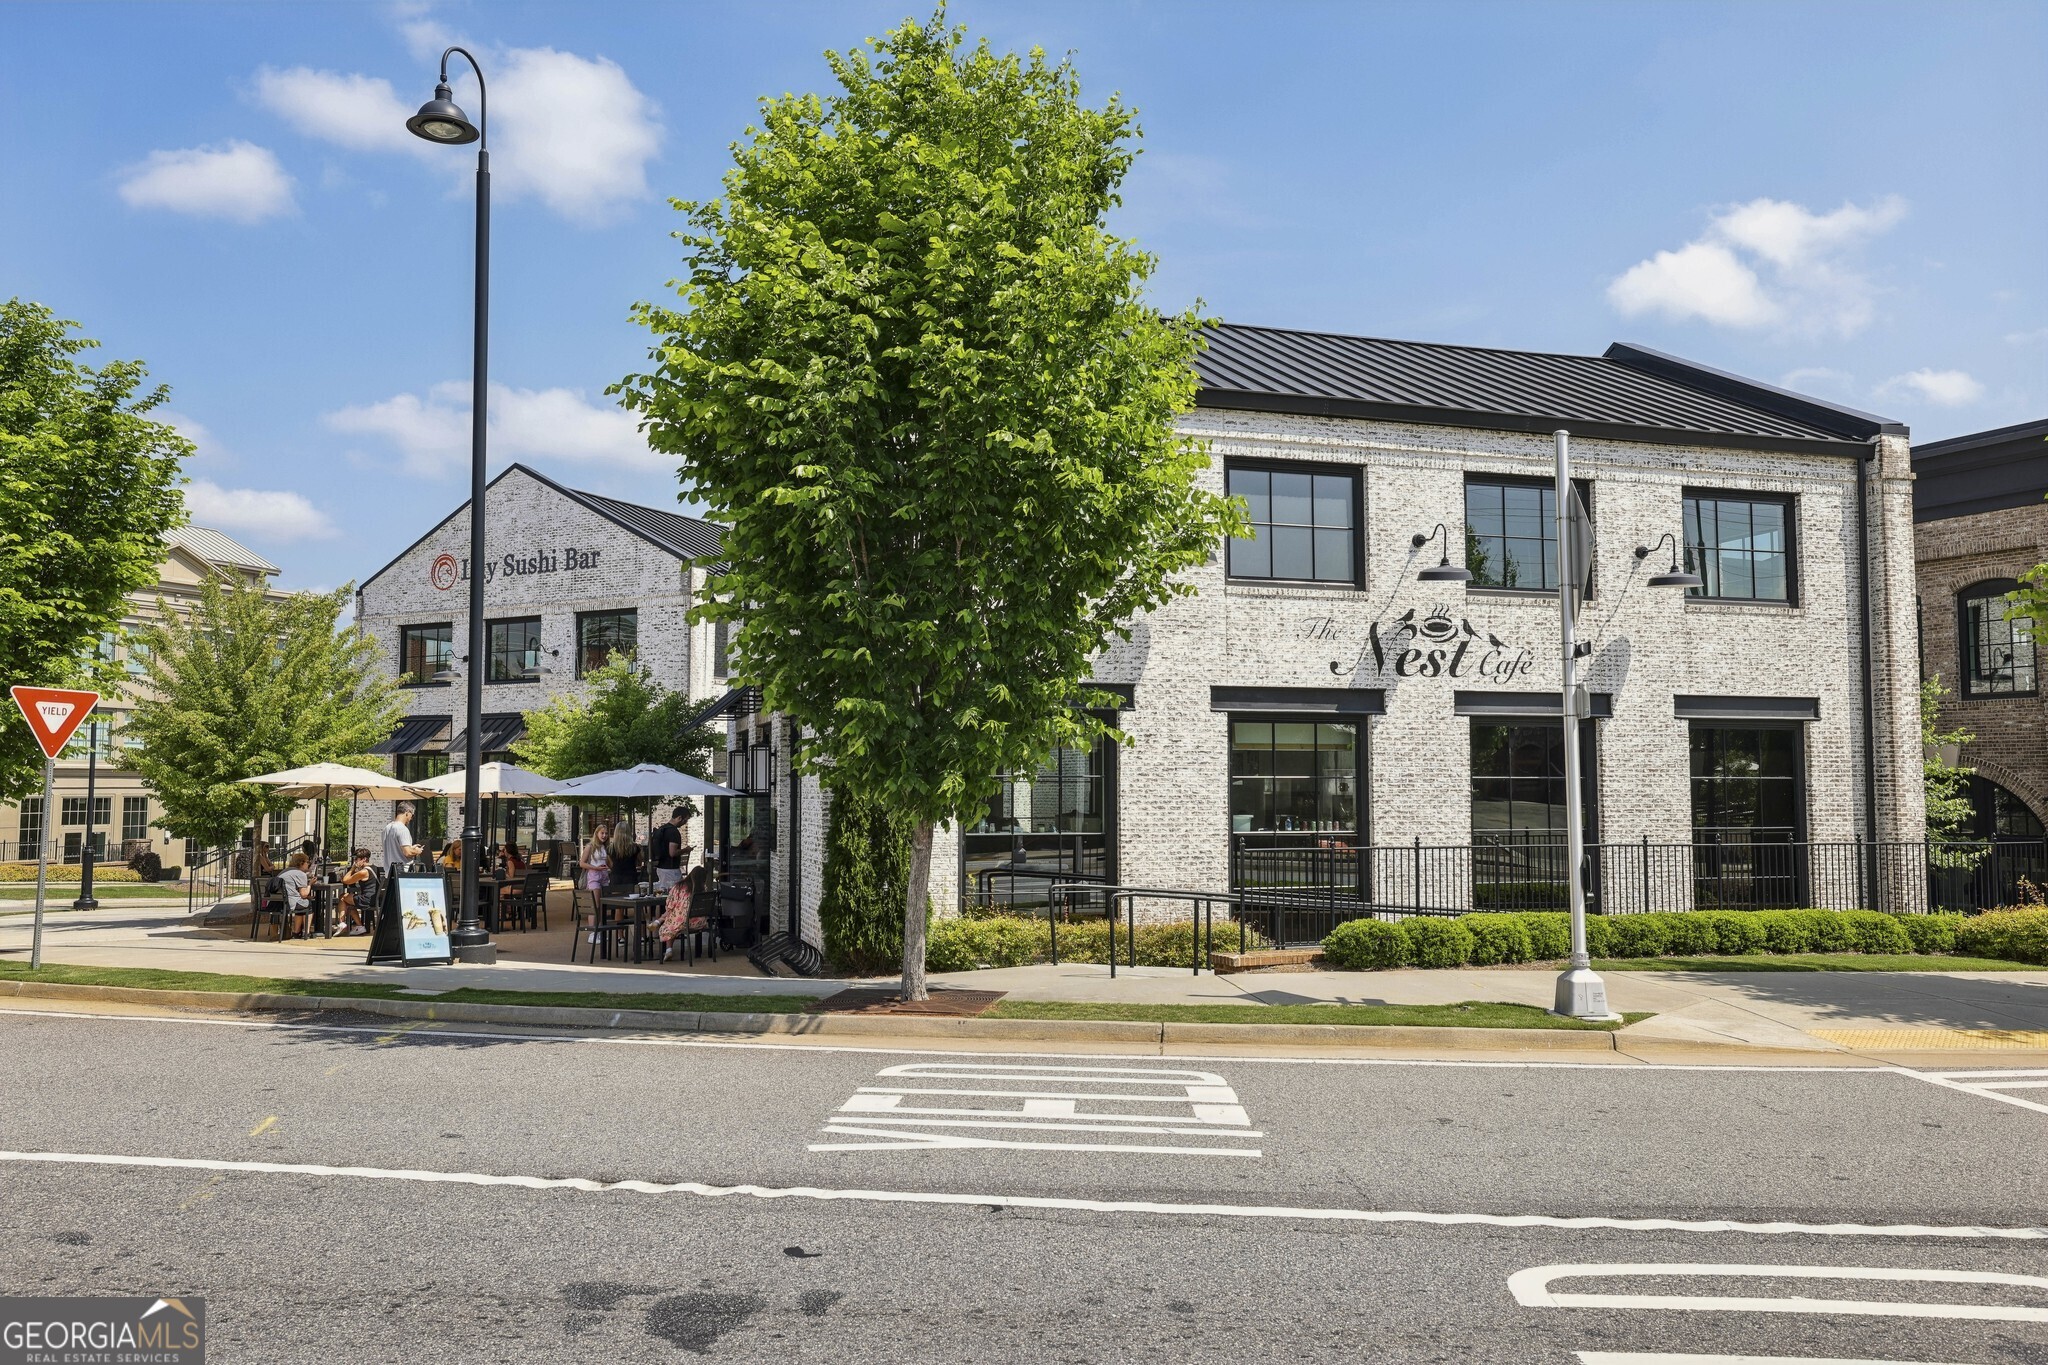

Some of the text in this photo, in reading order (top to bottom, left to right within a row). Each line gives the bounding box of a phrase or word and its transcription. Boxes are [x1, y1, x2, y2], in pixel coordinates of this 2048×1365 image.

[461, 547, 600, 584] Ly Sushi Bar
[1296, 616, 1341, 641] The
[1329, 620, 1534, 684] Nest Café
[42, 706, 68, 716] YIELD
